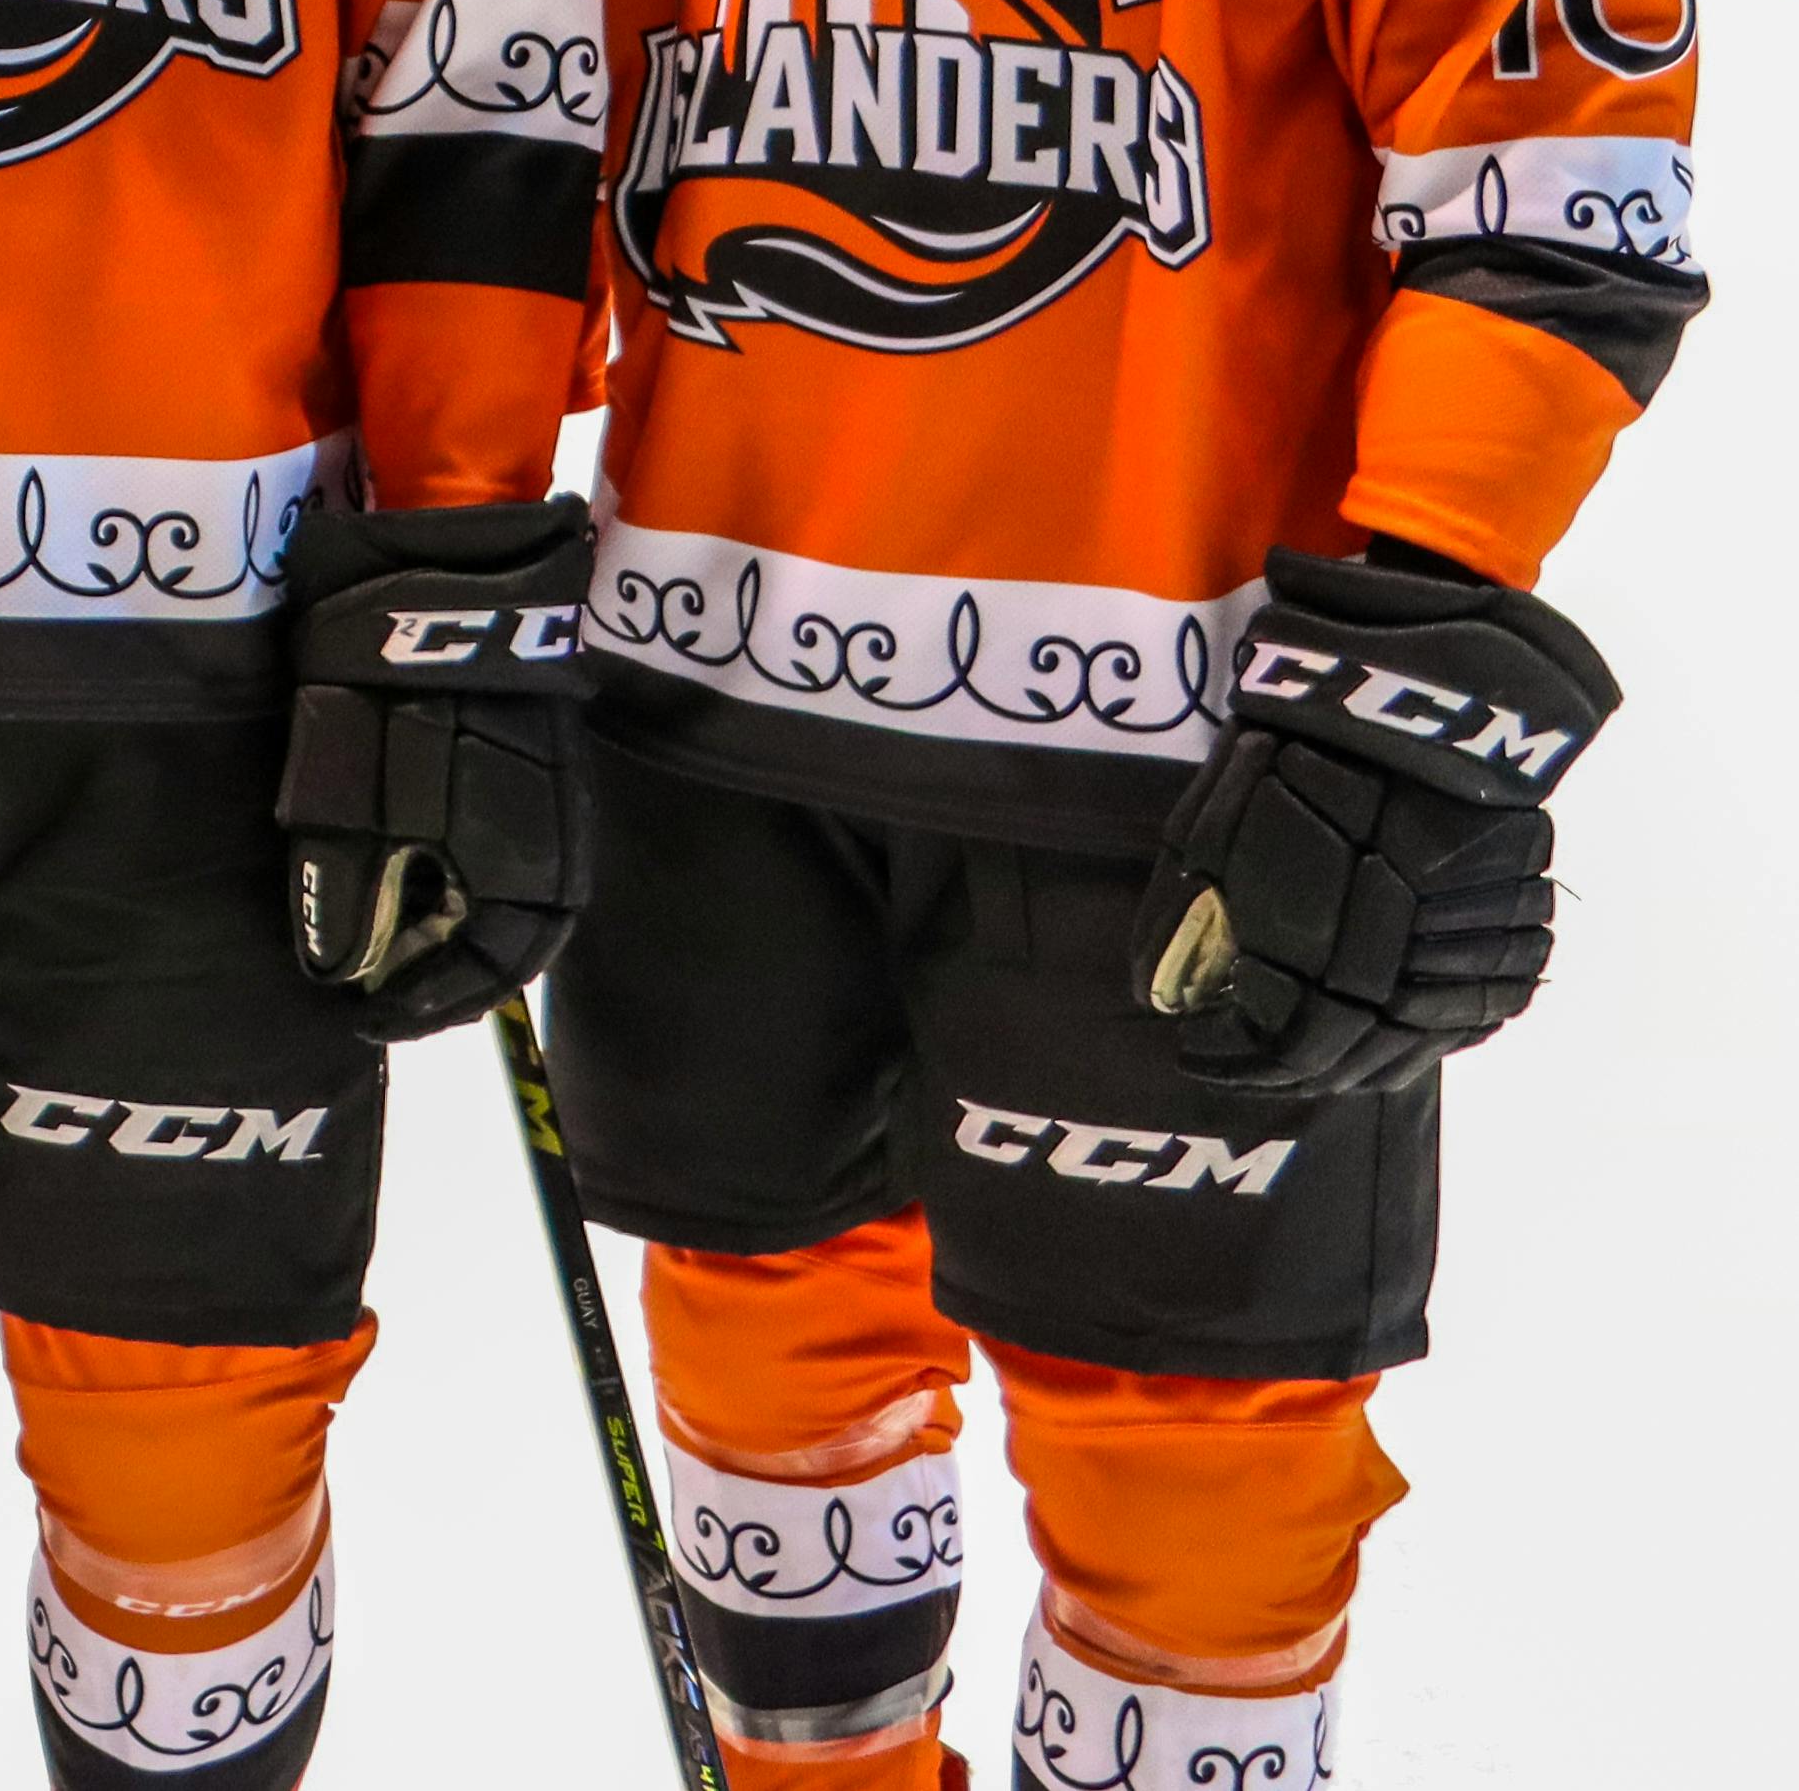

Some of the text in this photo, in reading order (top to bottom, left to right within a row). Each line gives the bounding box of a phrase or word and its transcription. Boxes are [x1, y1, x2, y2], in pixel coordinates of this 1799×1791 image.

[379, 604, 585, 665] CC
[1239, 640, 1572, 778] CCM
[302, 860, 322, 957] CCM
[0, 1083, 328, 1162] CCM
[955, 1098, 1297, 1196] CCM
[573, 1276, 598, 1331] GUAY
[608, 1415, 648, 1524] SUPER
